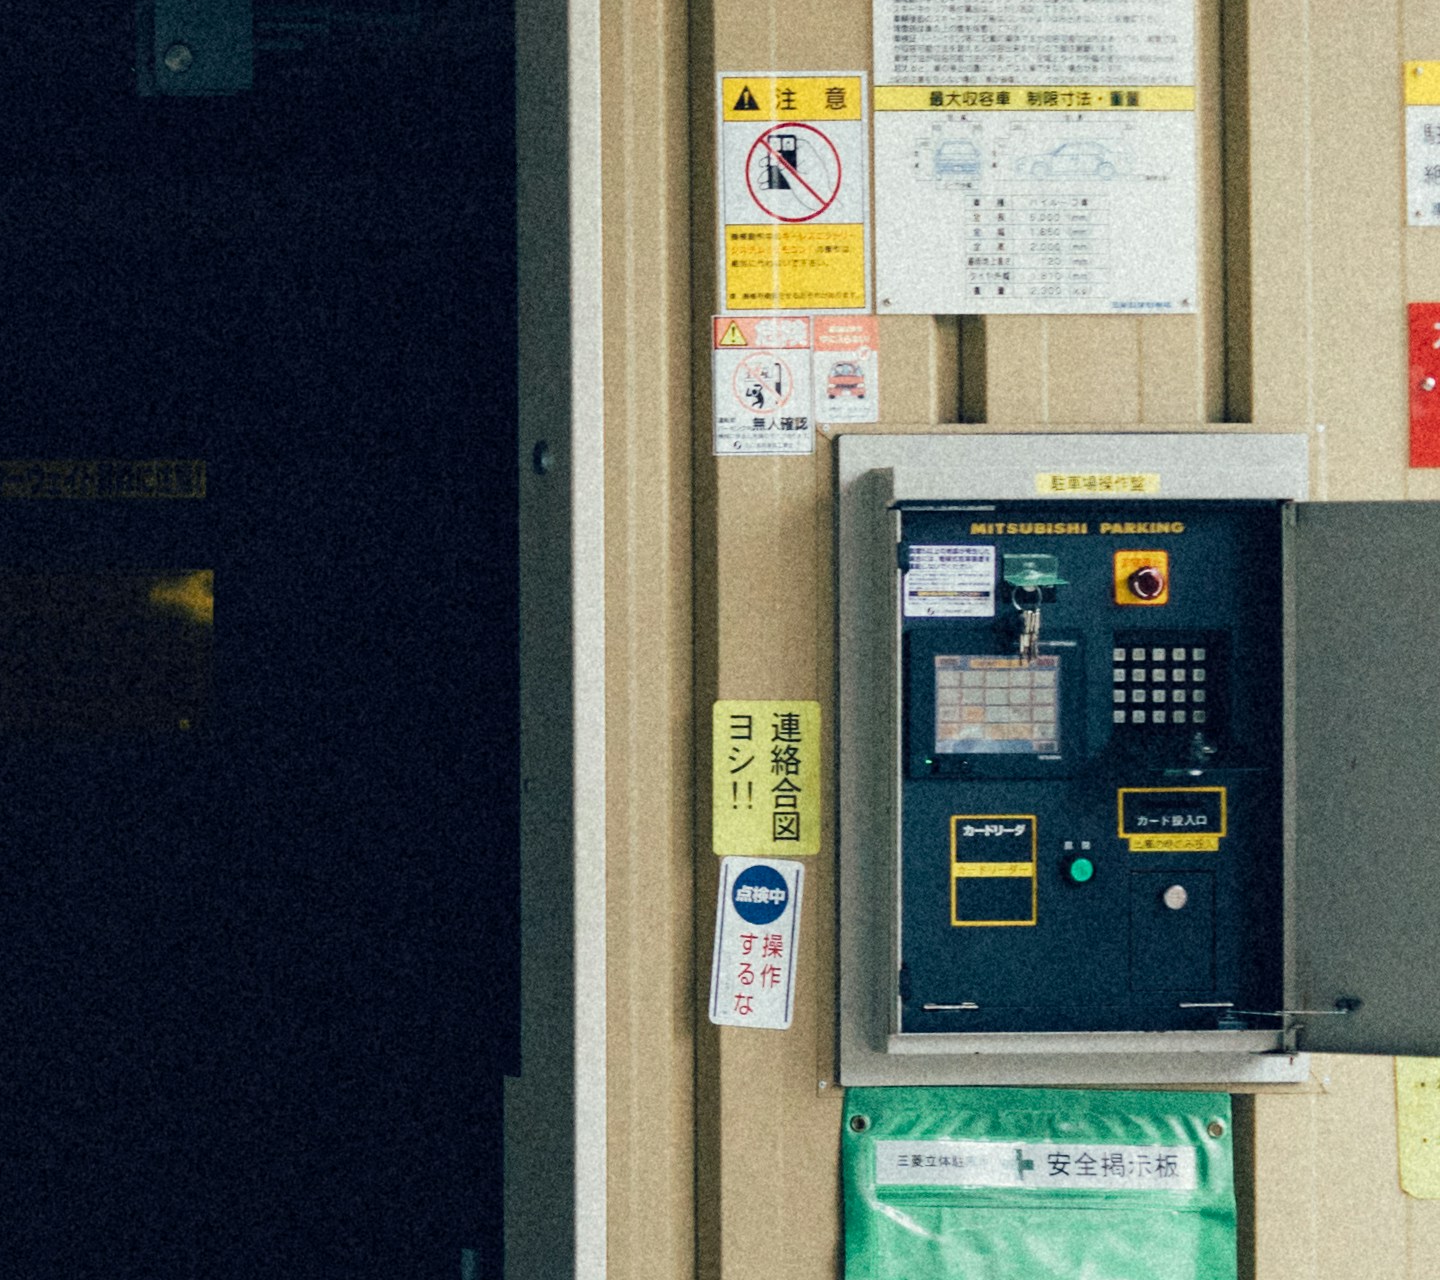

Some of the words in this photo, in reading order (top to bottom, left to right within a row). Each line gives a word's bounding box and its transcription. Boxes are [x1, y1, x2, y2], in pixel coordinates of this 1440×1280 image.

[775, 86, 848, 111] 注意
[929, 91, 1012, 107] 最大収容車
[753, 417, 808, 431] 無人確認
[1051, 475, 1145, 491] 駐車場操作盤
[970, 522, 1088, 535] MITSUBISHI
[1099, 522, 1185, 534] PARKING
[770, 711, 802, 843] 連絡合図
[1137, 815, 1208, 827] カード投入口
[963, 824, 1026, 837] カードリーダ
[735, 884, 786, 905] 点検中
[760, 933, 784, 989] 操作
[733, 932, 759, 1016] するな
[1046, 1151, 1180, 1179] 安全掲示板
